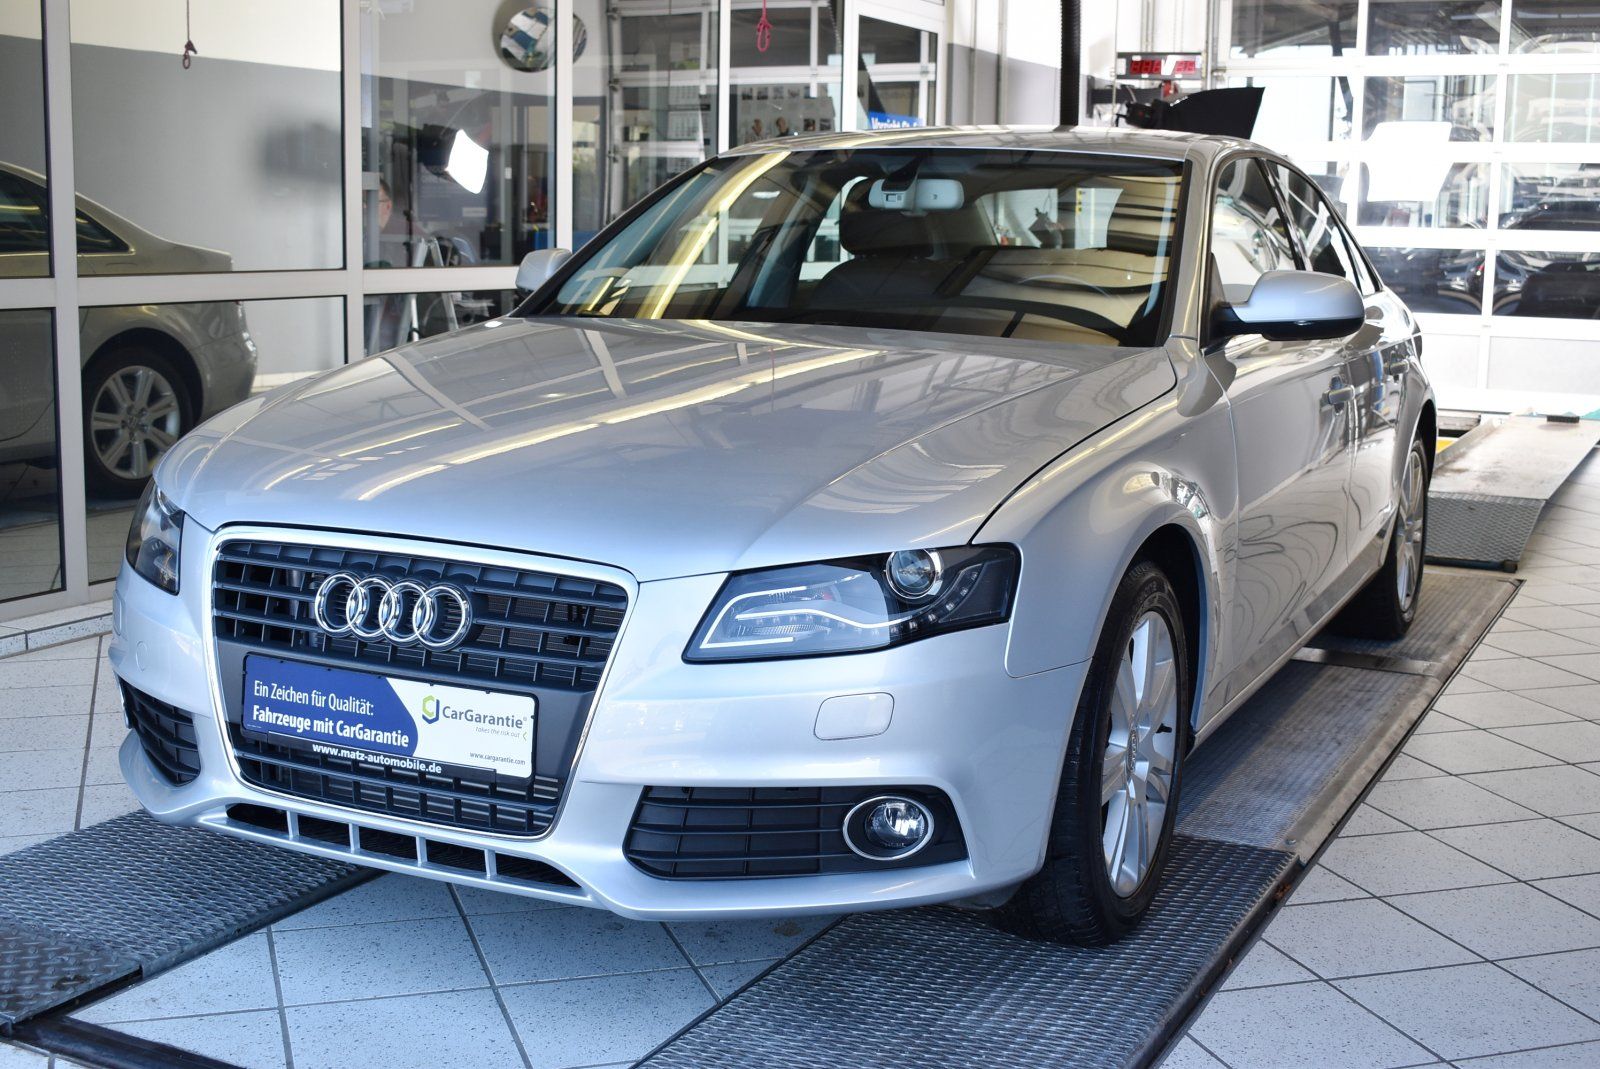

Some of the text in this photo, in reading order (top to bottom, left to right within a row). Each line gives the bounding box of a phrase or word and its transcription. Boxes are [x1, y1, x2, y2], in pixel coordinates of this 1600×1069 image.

[254, 680, 374, 716] Ein Zeichen für Qualität:
[252, 704, 409, 747] Fahrzeuge mit CarGarantie
[442, 705, 523, 729] CarGarantie
[312, 743, 442, 774] www.matz-automobile.de
[469, 751, 526, 766] www.cargarantie.com
